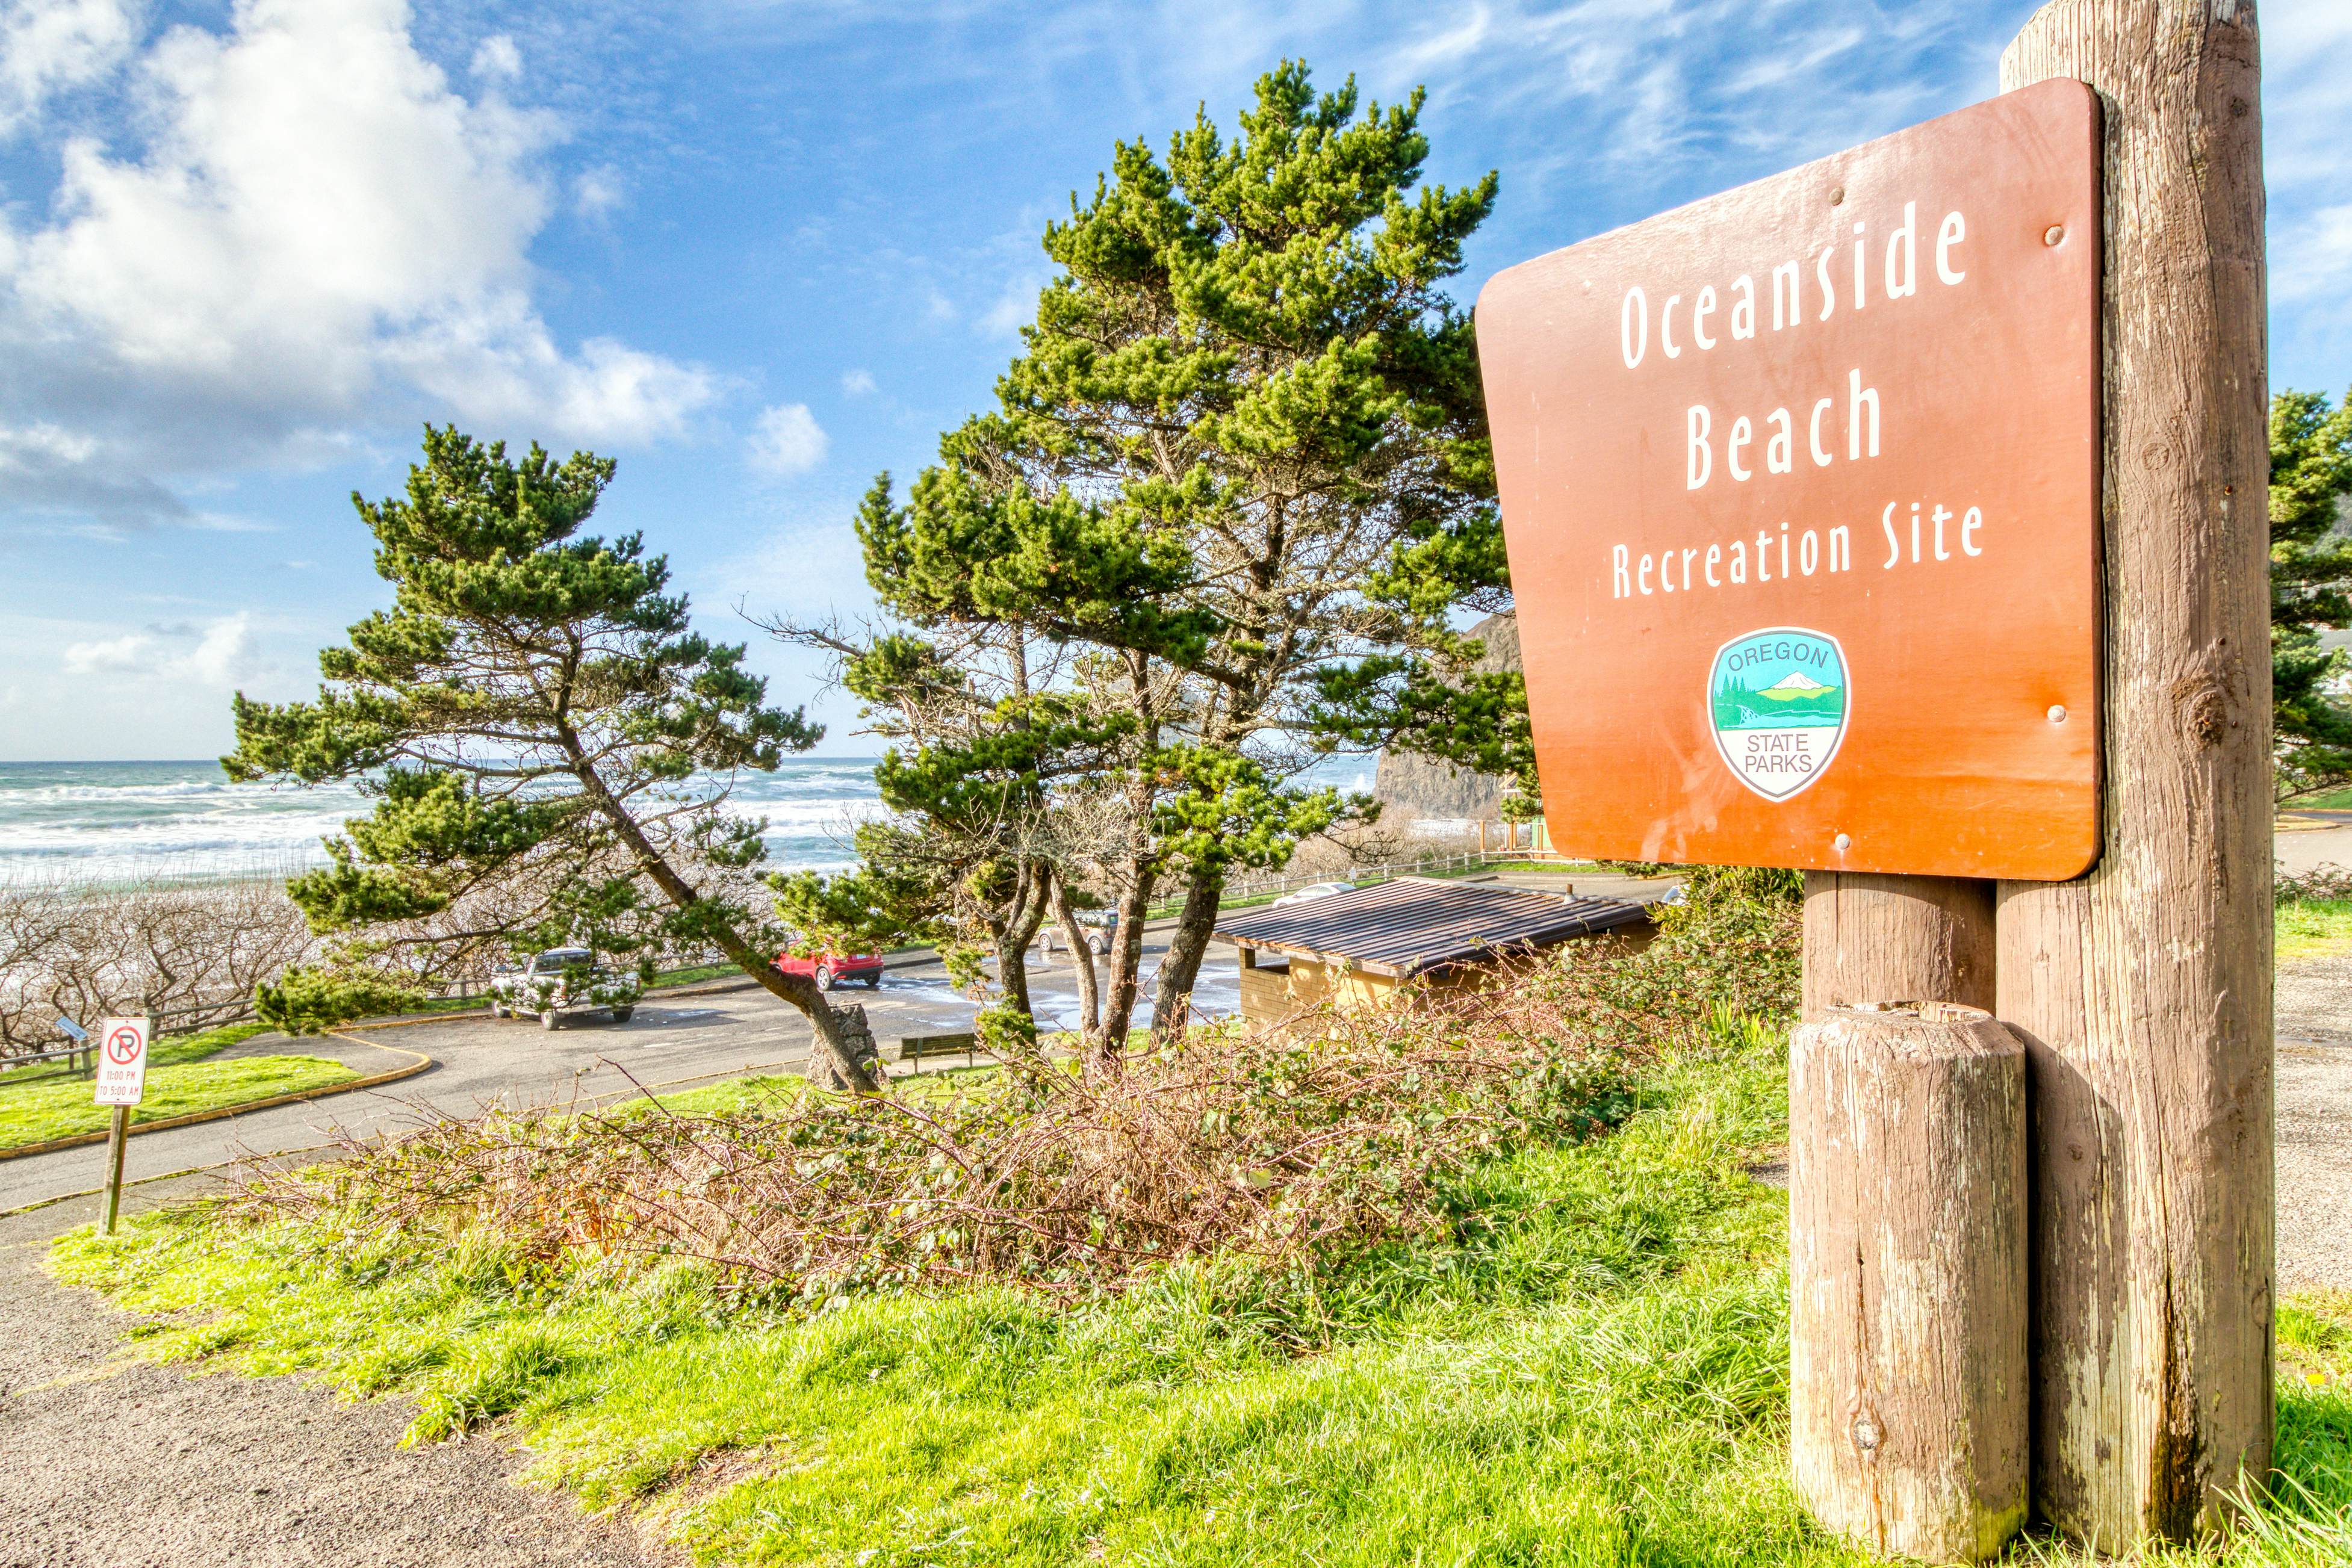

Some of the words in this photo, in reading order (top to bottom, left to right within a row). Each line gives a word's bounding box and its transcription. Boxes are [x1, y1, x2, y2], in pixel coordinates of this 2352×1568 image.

[1621, 201, 1965, 369] Oceanside
[1687, 368, 1879, 491] Beach
[1613, 522, 1850, 598] Recreation
[1882, 501, 1982, 569] Site
[1728, 642, 1828, 671] OREGON
[1747, 733, 1808, 752] STATE
[1745, 754, 1812, 772] PARKS
[107, 1071, 123, 1080] 11:00
[126, 1071, 135, 1080] PM
[100, 1086, 107, 1095] TO
[110, 1086, 126, 1095] 5:00
[129, 1086, 138, 1095] AM
